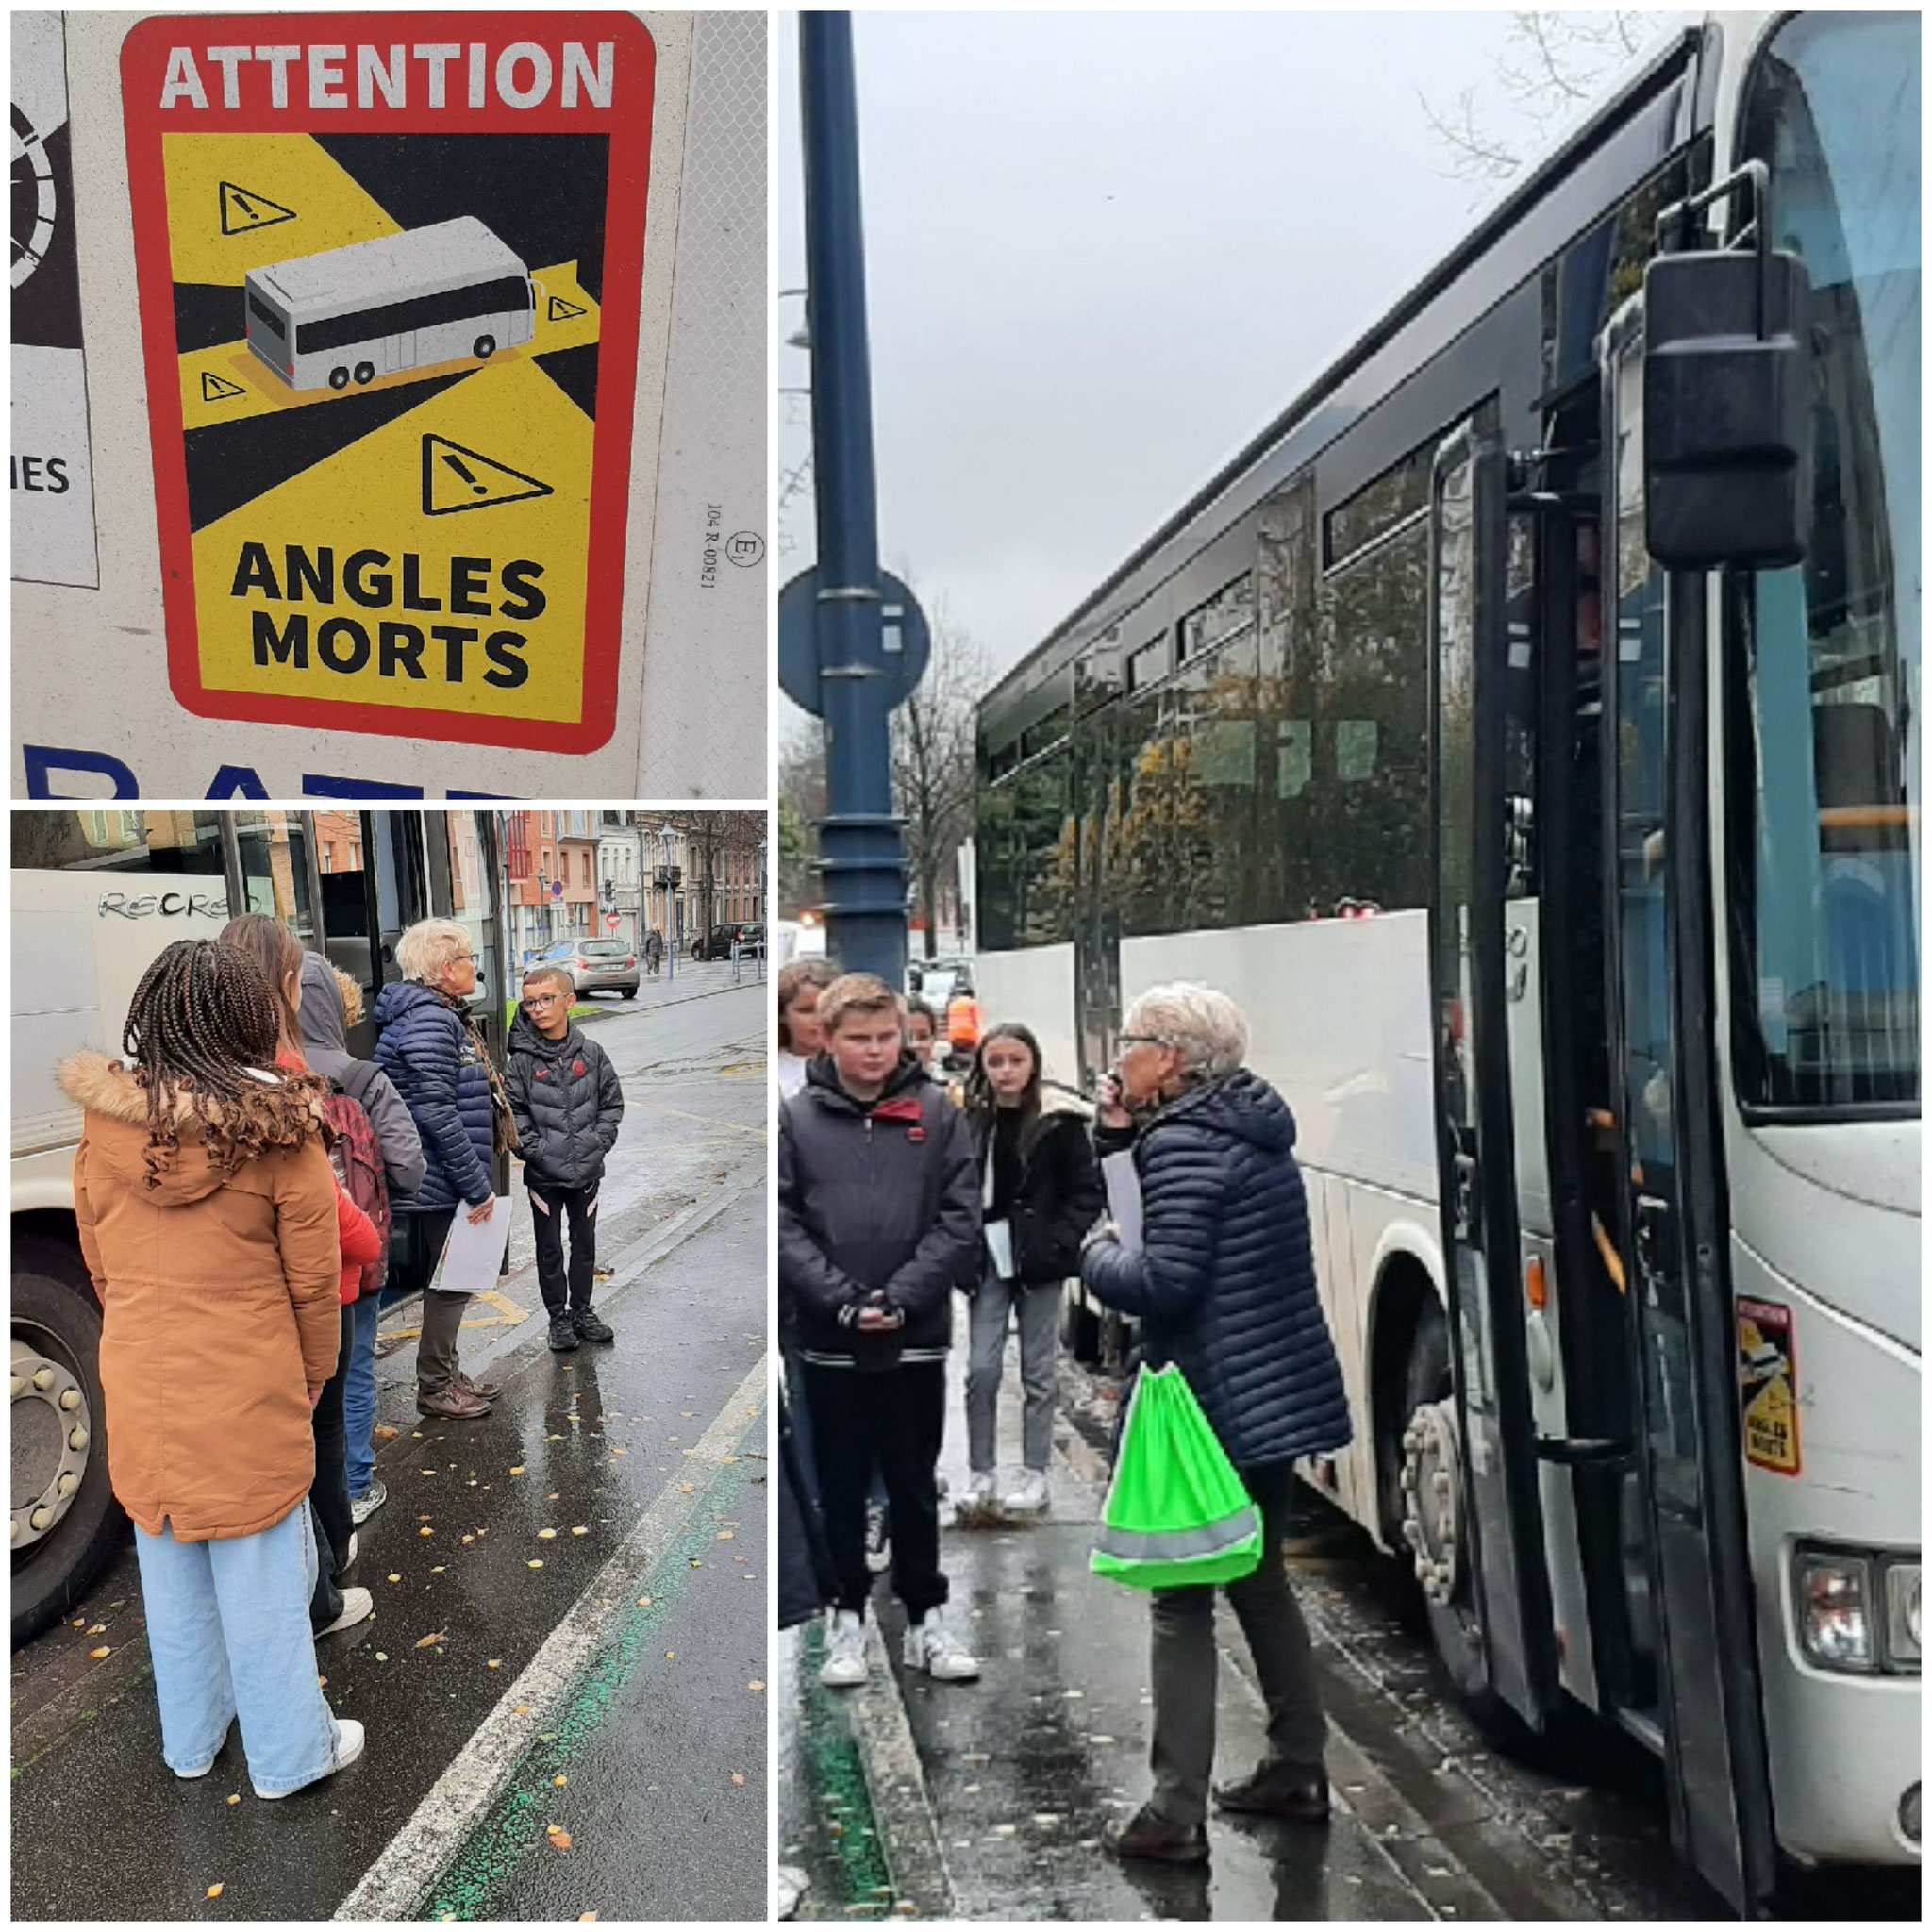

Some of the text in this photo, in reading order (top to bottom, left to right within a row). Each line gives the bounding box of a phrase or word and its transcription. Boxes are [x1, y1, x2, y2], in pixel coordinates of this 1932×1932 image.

[159, 42, 614, 110] ATTENTION
[230, 541, 546, 620] ANGLES
[701, 504, 722, 589] 104 R-00821
[252, 610, 529, 688] MORTS
